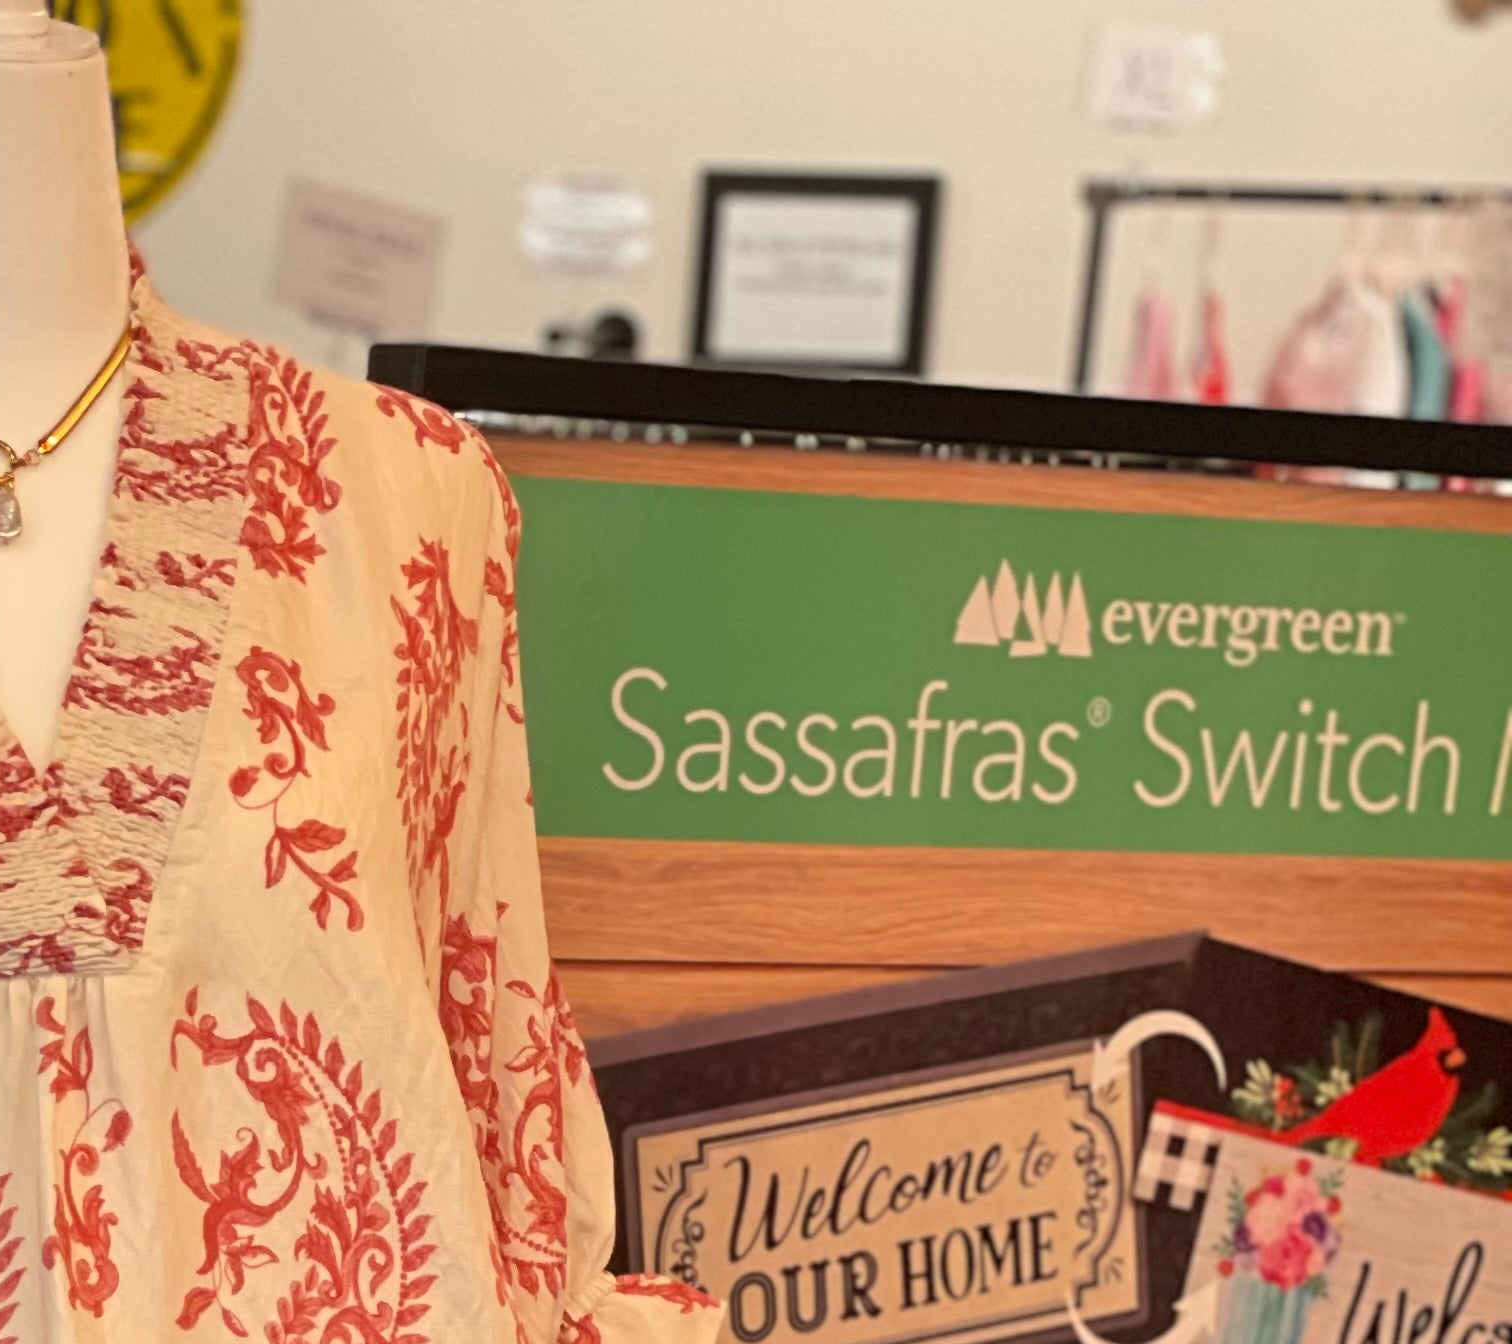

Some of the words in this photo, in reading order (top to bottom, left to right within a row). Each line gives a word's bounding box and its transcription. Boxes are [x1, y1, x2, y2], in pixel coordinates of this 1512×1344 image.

[1101, 600, 1394, 666] evergreen
[1133, 688, 1462, 815] Switch
[723, 1138, 1008, 1264] Welcome
[1017, 1130, 1058, 1190] to
[729, 1250, 884, 1344] OUR
[897, 1210, 1060, 1310] HOME
